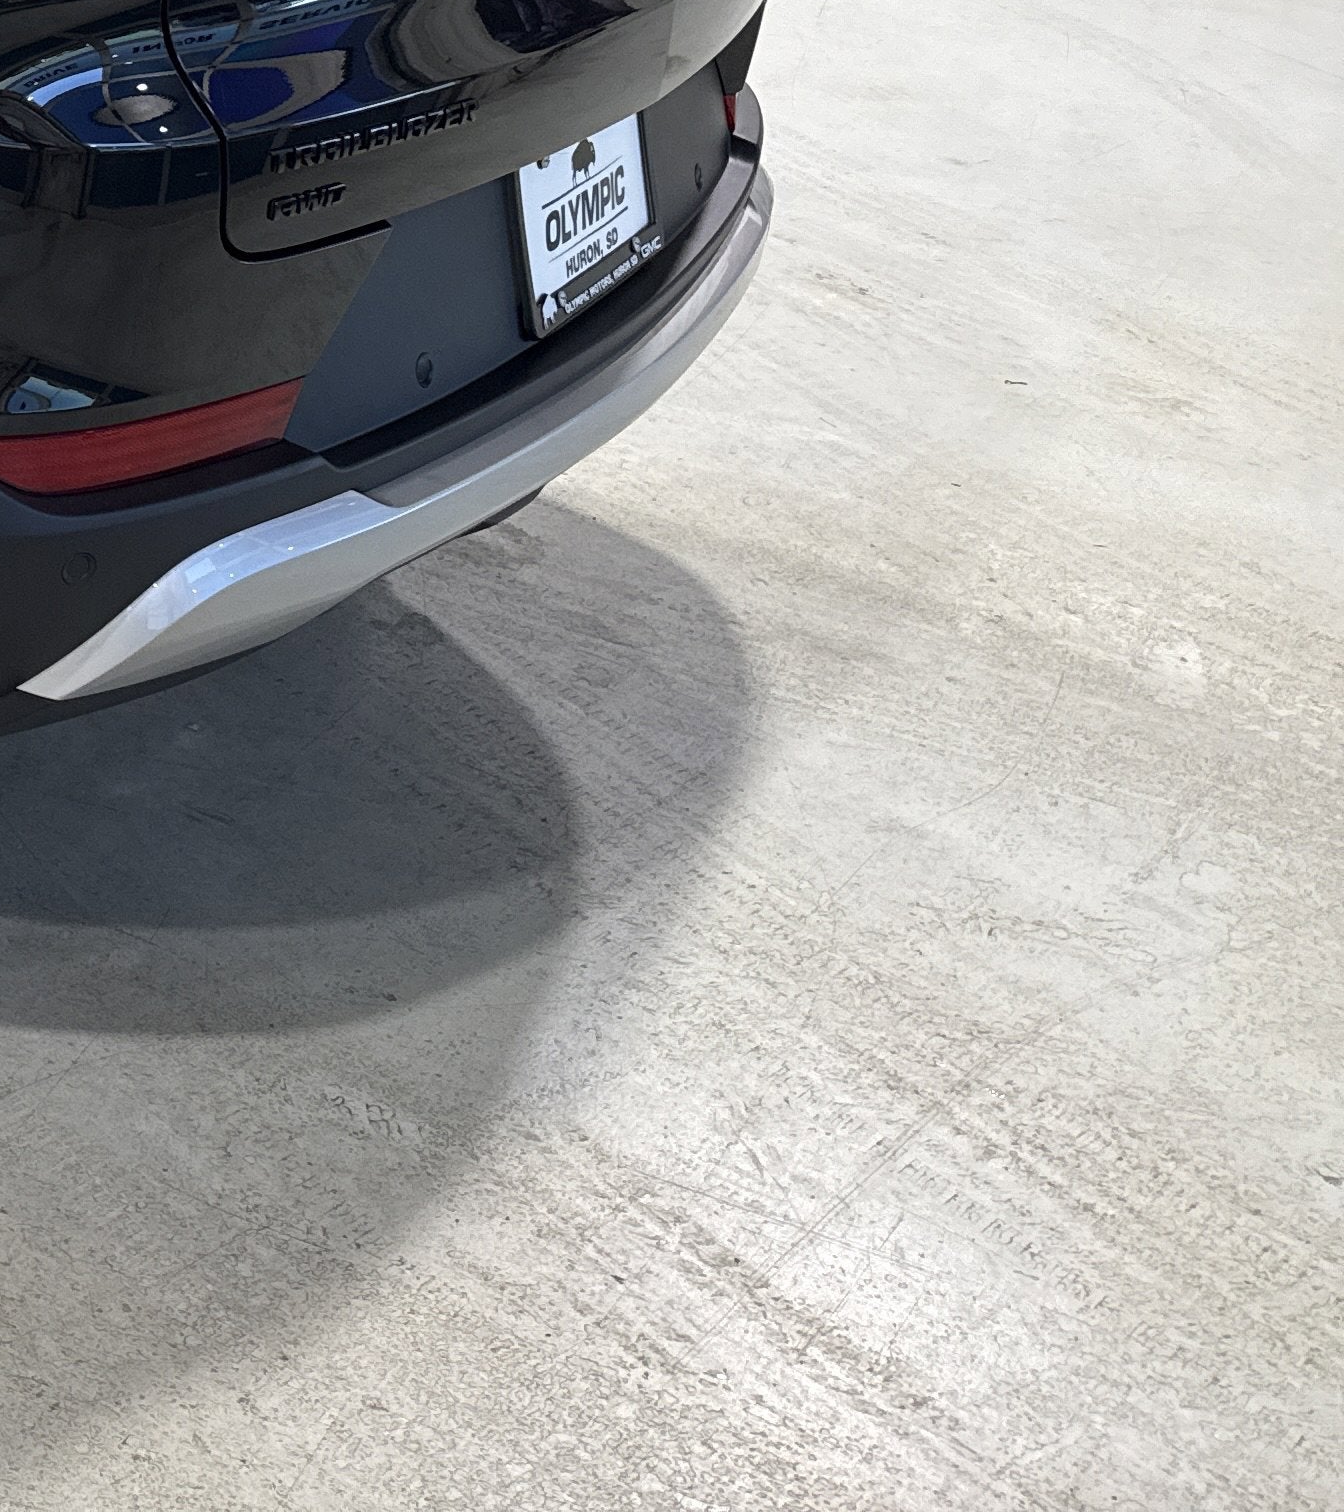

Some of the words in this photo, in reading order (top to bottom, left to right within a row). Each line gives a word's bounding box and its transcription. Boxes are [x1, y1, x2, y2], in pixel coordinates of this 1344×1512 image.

[546, 165, 625, 252] OLYMPIC
[566, 239, 604, 278] HURON,
[607, 227, 618, 249] SD
